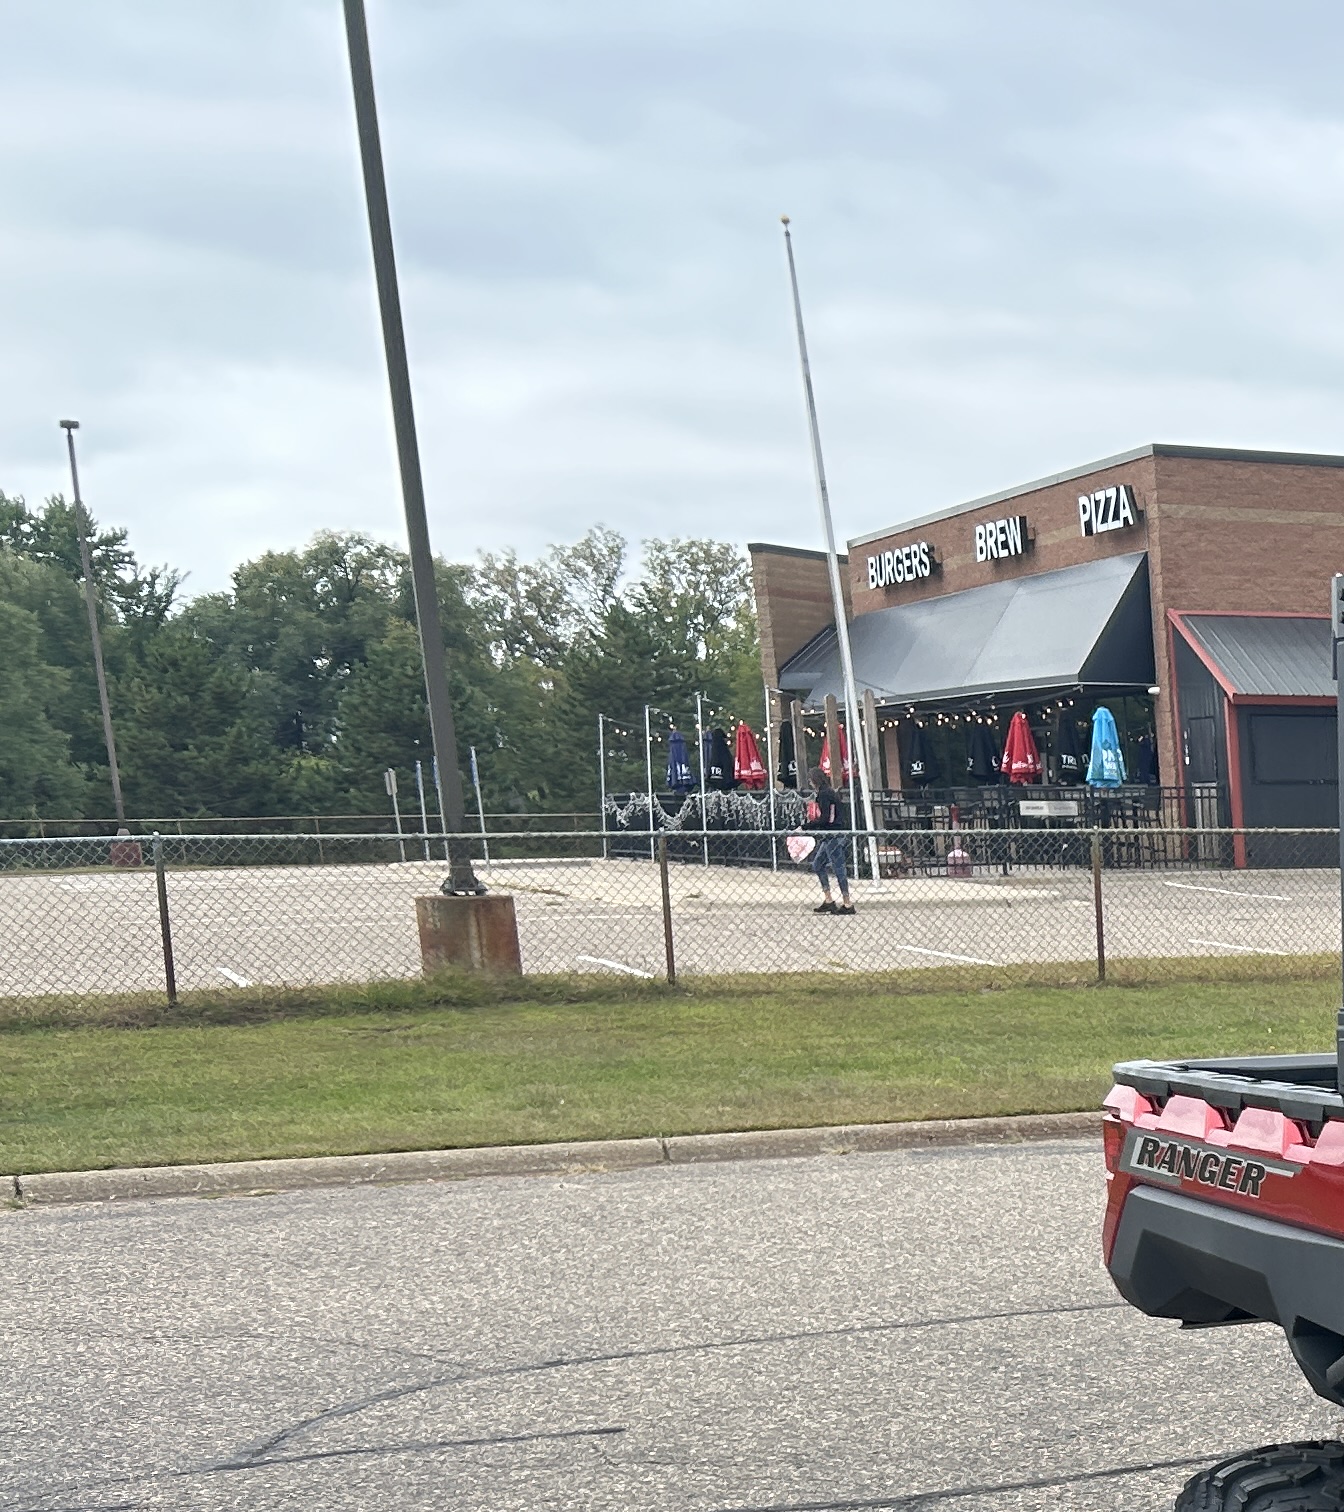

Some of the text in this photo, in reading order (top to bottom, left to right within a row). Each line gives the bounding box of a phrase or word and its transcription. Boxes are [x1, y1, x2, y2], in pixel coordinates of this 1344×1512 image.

[867, 484, 1134, 590] BURGERS BREW PIZZA
[1136, 1135, 1267, 1198] RANGER
